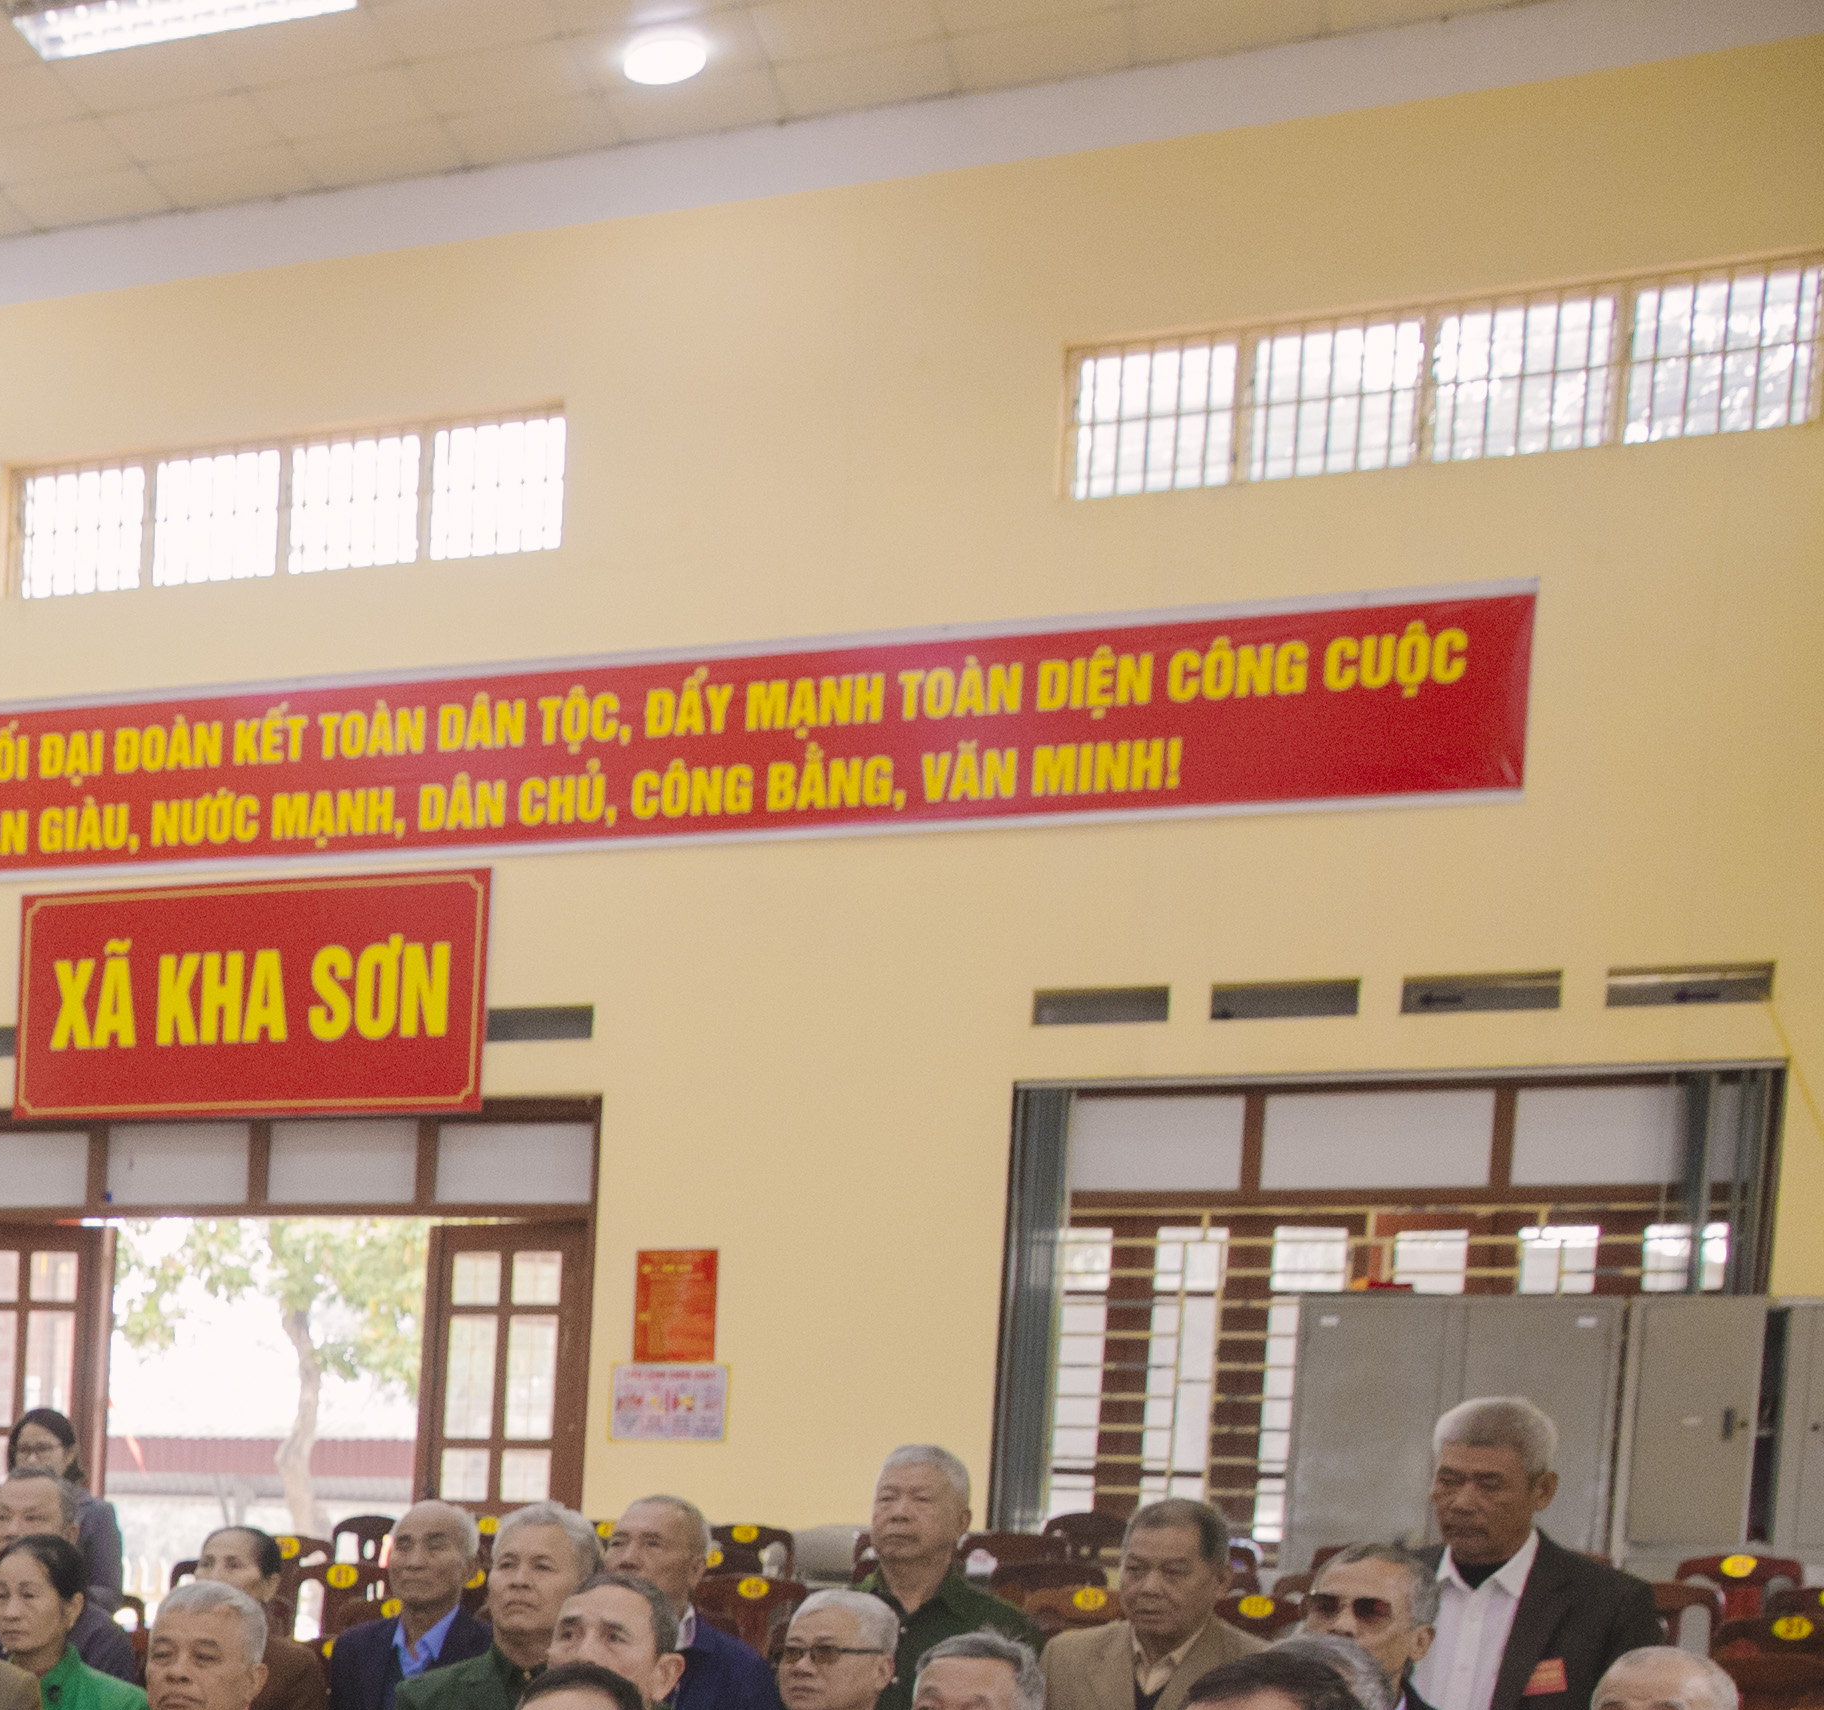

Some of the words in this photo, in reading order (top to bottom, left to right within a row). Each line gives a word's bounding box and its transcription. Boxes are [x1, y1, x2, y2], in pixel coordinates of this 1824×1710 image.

[40, 729, 104, 788] ĐẠI
[115, 715, 222, 774] ĐOÀN
[234, 702, 308, 766] KẾT
[320, 700, 427, 761] TOÀN
[438, 692, 525, 751] DÂN
[538, 685, 631, 753] TỘC,
[645, 666, 733, 738] ĐẨY
[746, 674, 883, 737] MẠNH
[899, 653, 1024, 721] TOÀN
[1039, 644, 1153, 719] DIỆN
[1168, 637, 1307, 703] CÔNG
[1323, 620, 1469, 696] CUỘC
[39, 796, 139, 854] GIÀU,
[152, 786, 260, 847] NƯỚC
[272, 785, 405, 848] MẠNH,
[418, 771, 506, 831] DÂN
[518, 758, 617, 826] CHỦ,
[631, 759, 753, 820] CÔNG
[766, 743, 907, 813] BẰNG,
[921, 738, 1016, 804] VĂN
[1031, 736, 1183, 796] MINH!
[50, 939, 136, 1050] XÃ
[155, 948, 286, 1046] KHA
[308, 934, 451, 1041] SƠN
